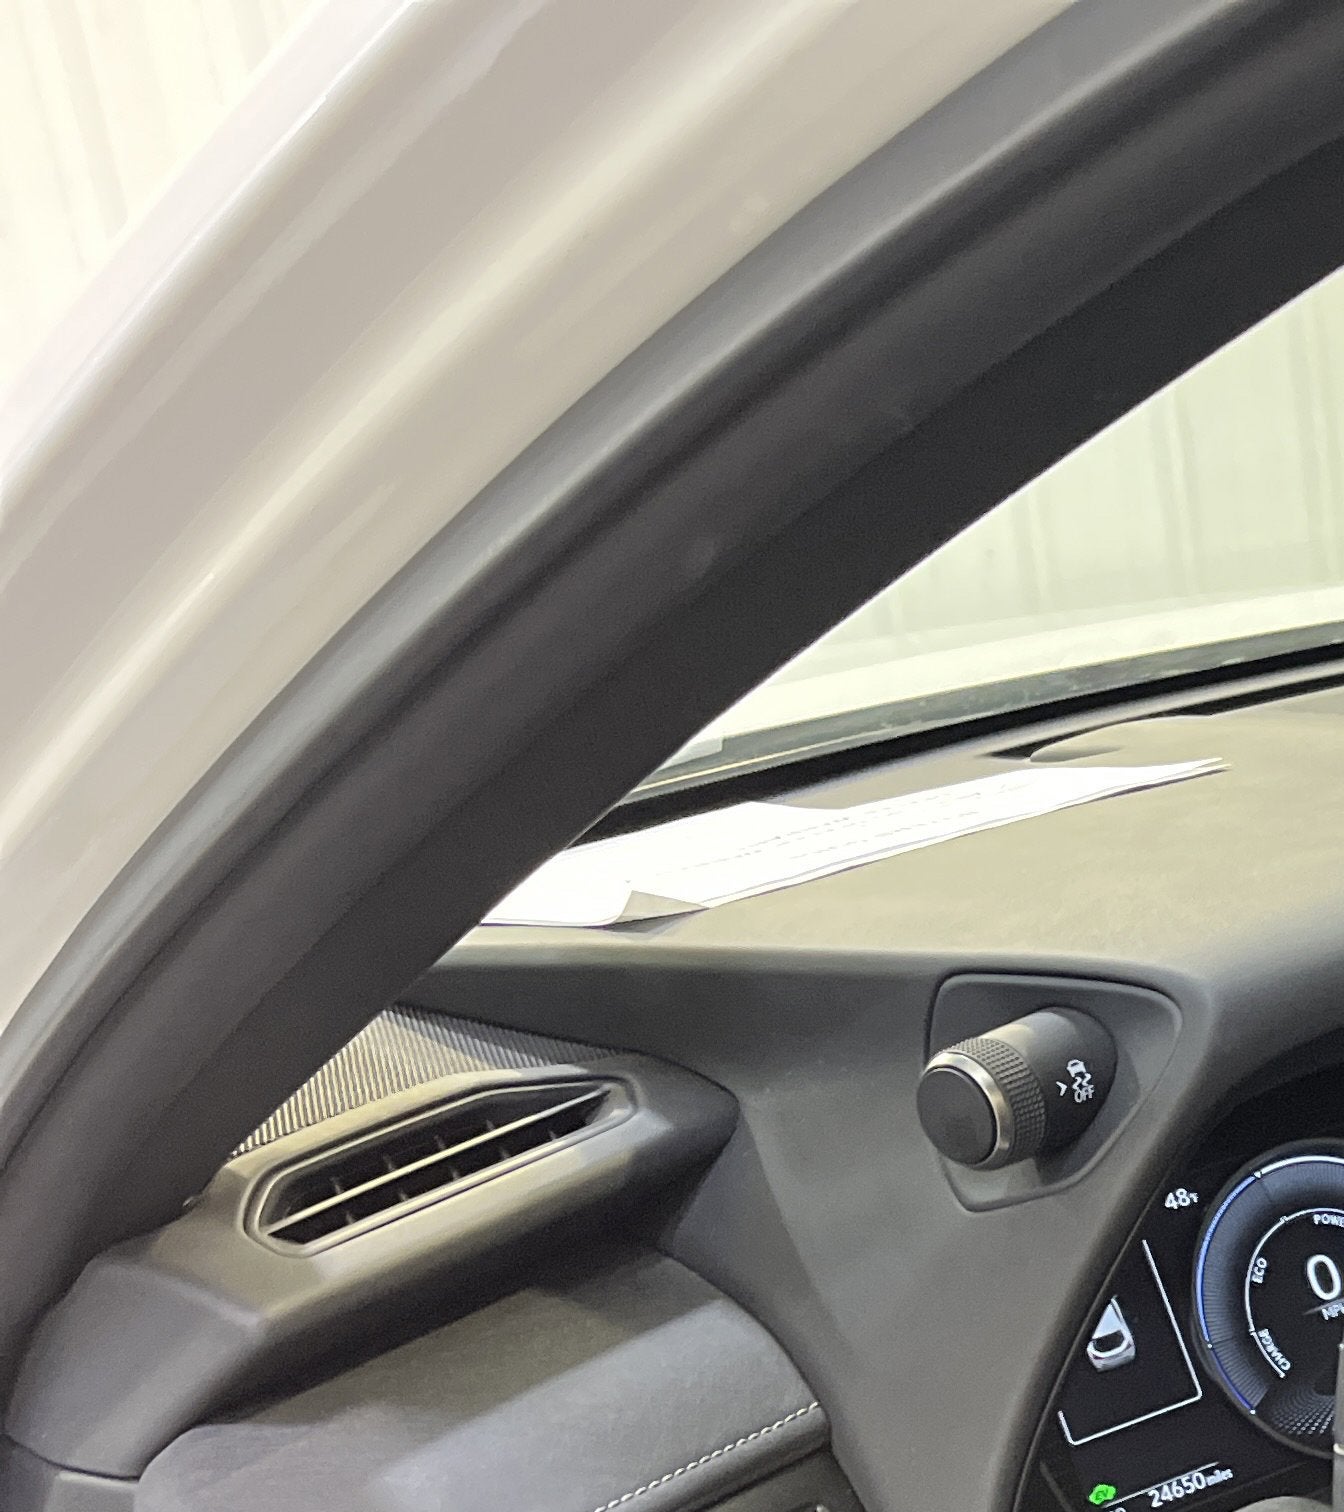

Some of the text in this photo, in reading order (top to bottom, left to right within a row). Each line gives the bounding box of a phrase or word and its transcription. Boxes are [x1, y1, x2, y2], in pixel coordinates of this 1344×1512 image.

[1251, 1256, 1268, 1285] ECO
[1306, 1254, 1342, 1301] 0
[1256, 1328, 1292, 1372] CHARGE
